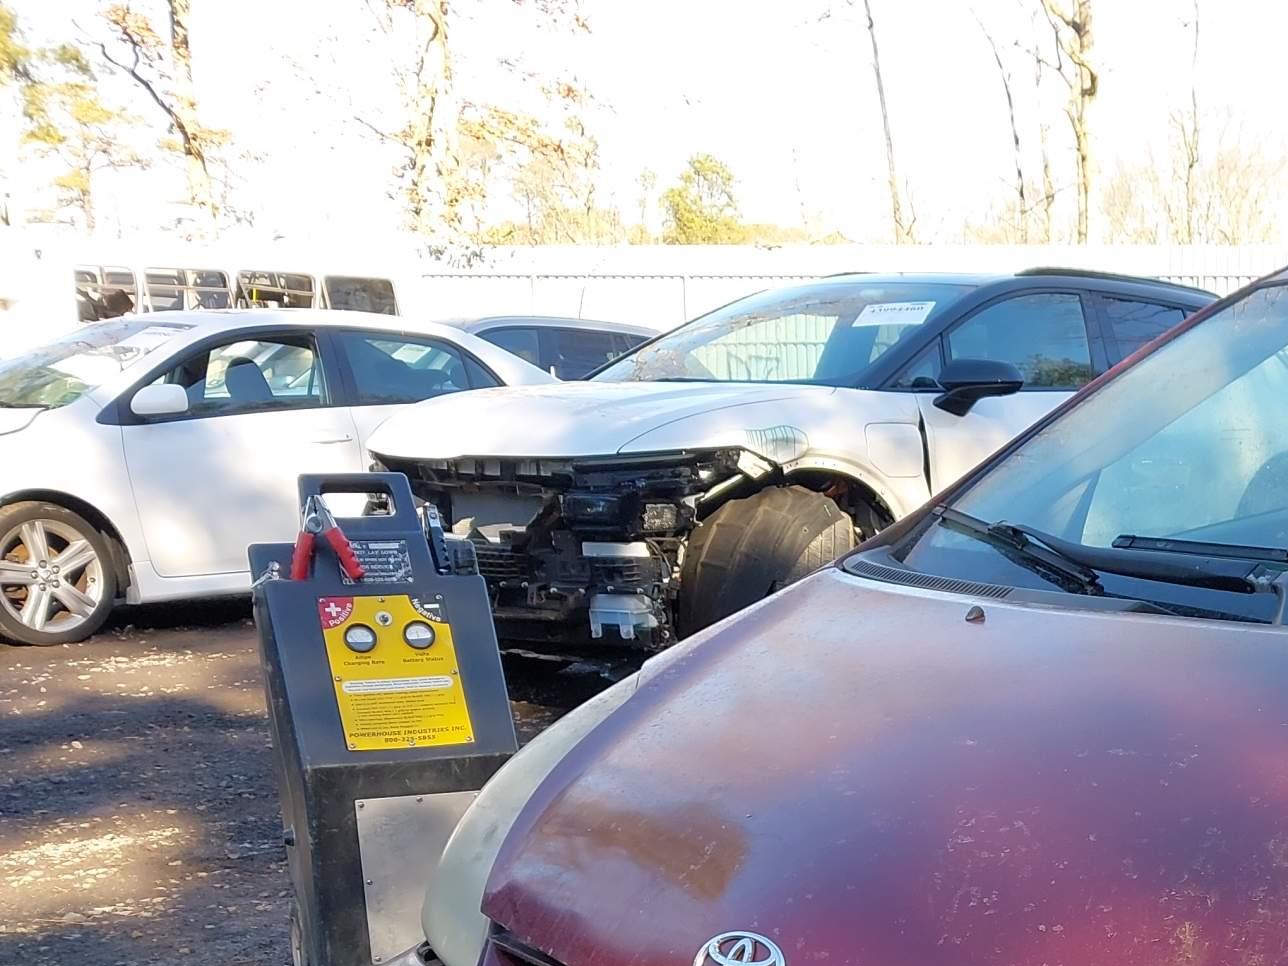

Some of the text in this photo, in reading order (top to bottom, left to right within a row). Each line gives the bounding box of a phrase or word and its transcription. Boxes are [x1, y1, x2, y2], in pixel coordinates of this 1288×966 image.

[328, 602, 353, 627] Positive
[411, 598, 441, 622] Negative
[349, 729, 401, 739] POWERHOUSE
[404, 727, 449, 736] INDUSTRIES
